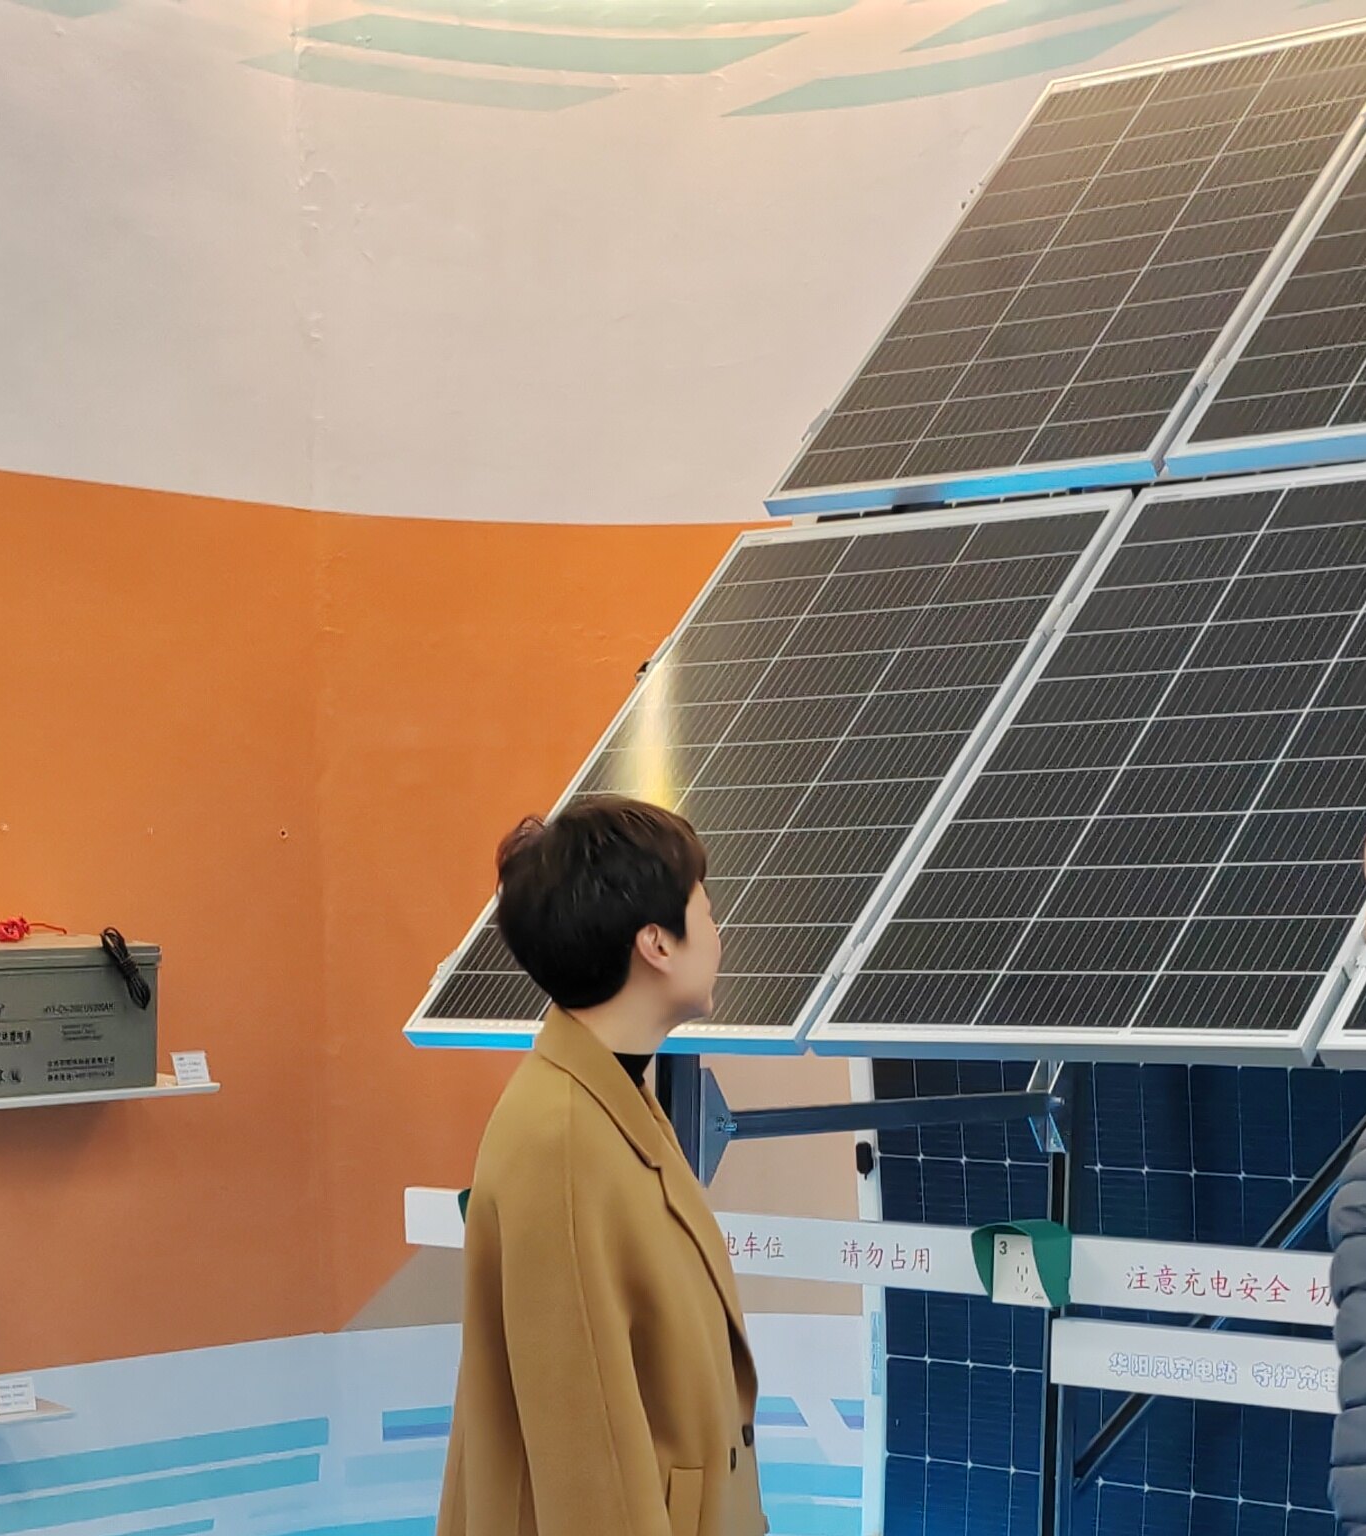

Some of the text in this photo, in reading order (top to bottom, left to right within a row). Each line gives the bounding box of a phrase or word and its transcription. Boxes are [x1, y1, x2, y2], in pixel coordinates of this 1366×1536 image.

[840, 1240, 931, 1273] 请勿占用
[998, 1240, 1008, 1256] 3
[1125, 1264, 1292, 1304] 注意充电安全
[1108, 1352, 1337, 1392] 华阳风充电站 守护充电
